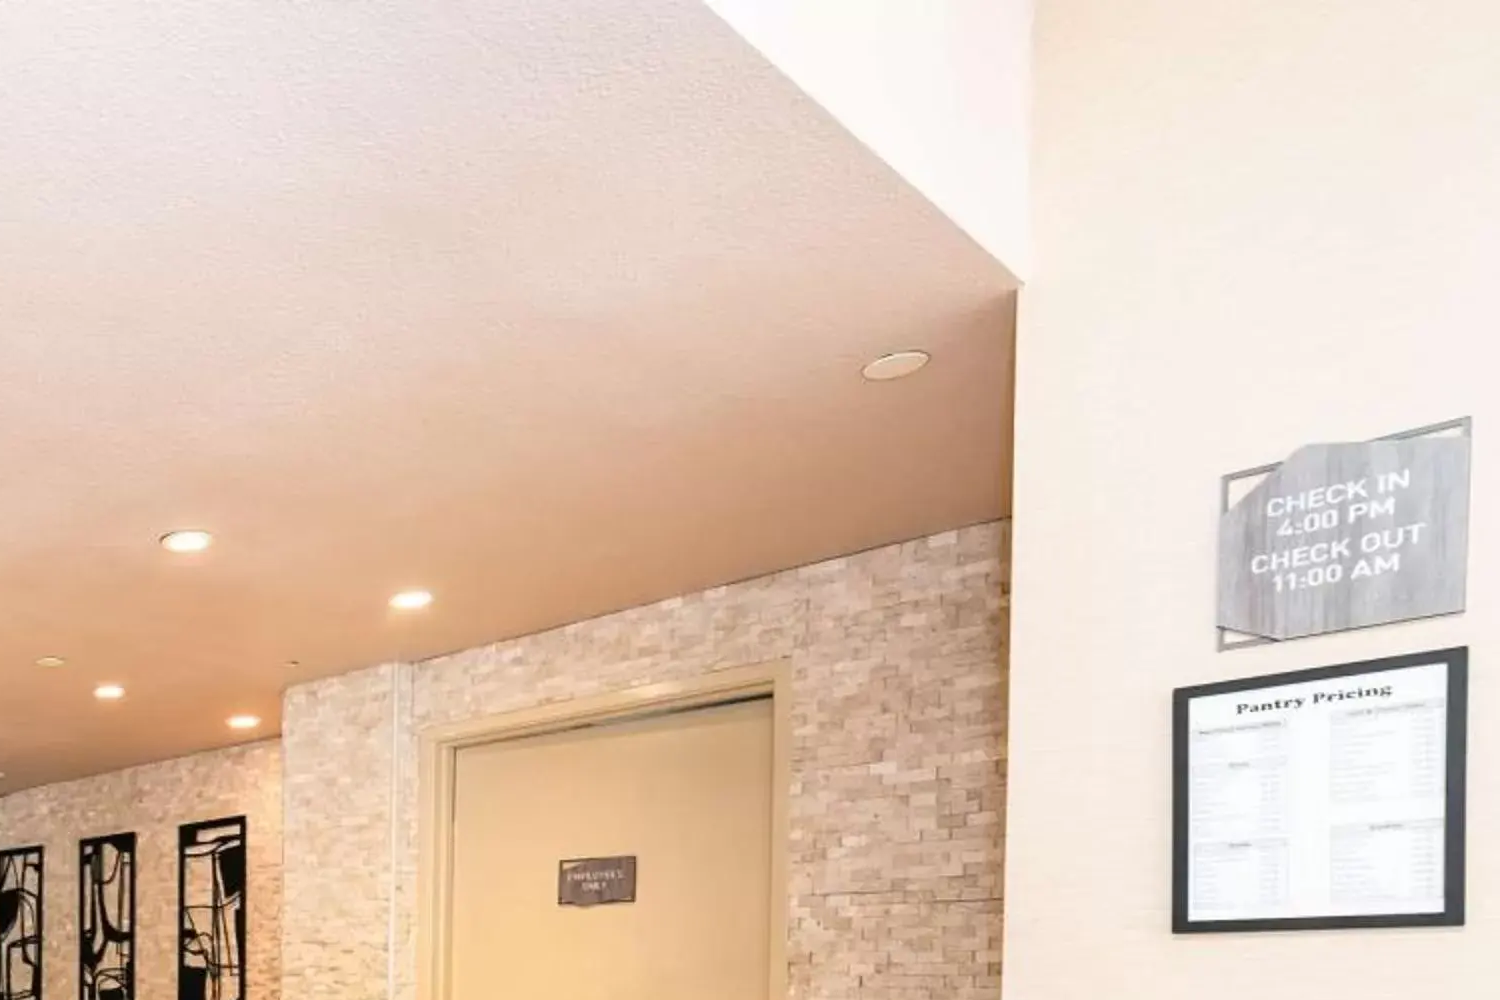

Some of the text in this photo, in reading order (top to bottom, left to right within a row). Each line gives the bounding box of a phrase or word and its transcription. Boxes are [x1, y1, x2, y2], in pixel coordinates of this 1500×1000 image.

[1266, 469, 1410, 517] CHECK IN
[1277, 496, 1396, 537] 4:00 PM
[1251, 523, 1427, 575] CHECK OUT
[1272, 553, 1400, 593] 11:00 AM
[1236, 686, 1393, 715] Pantry Pricing
